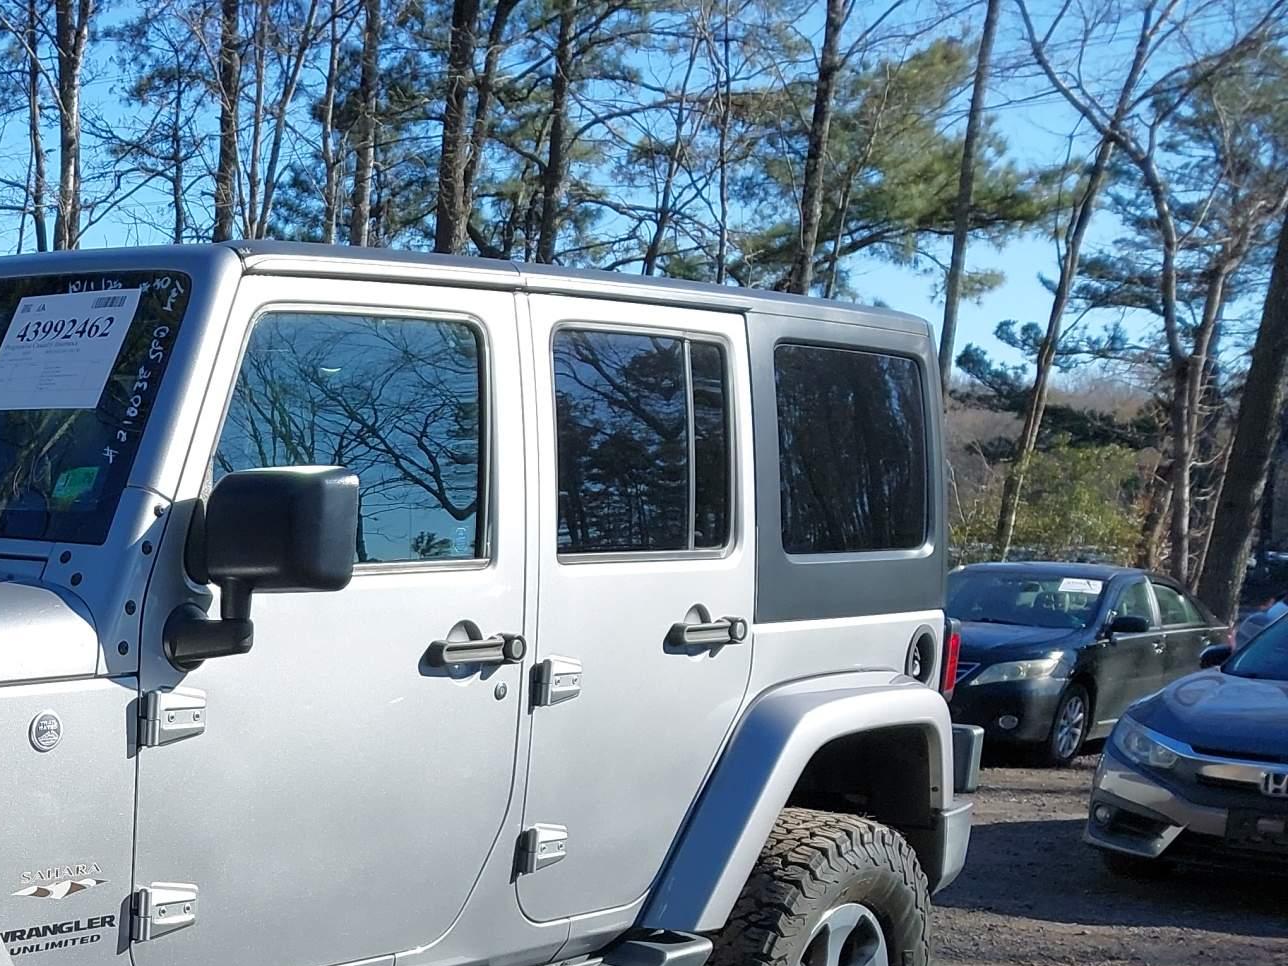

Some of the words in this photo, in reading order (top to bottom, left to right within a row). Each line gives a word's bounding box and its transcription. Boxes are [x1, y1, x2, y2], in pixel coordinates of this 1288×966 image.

[16, 316, 115, 342] 43992462
[20, 862, 103, 884] SAHARA
[9, 934, 101, 956] UNLIMITED
